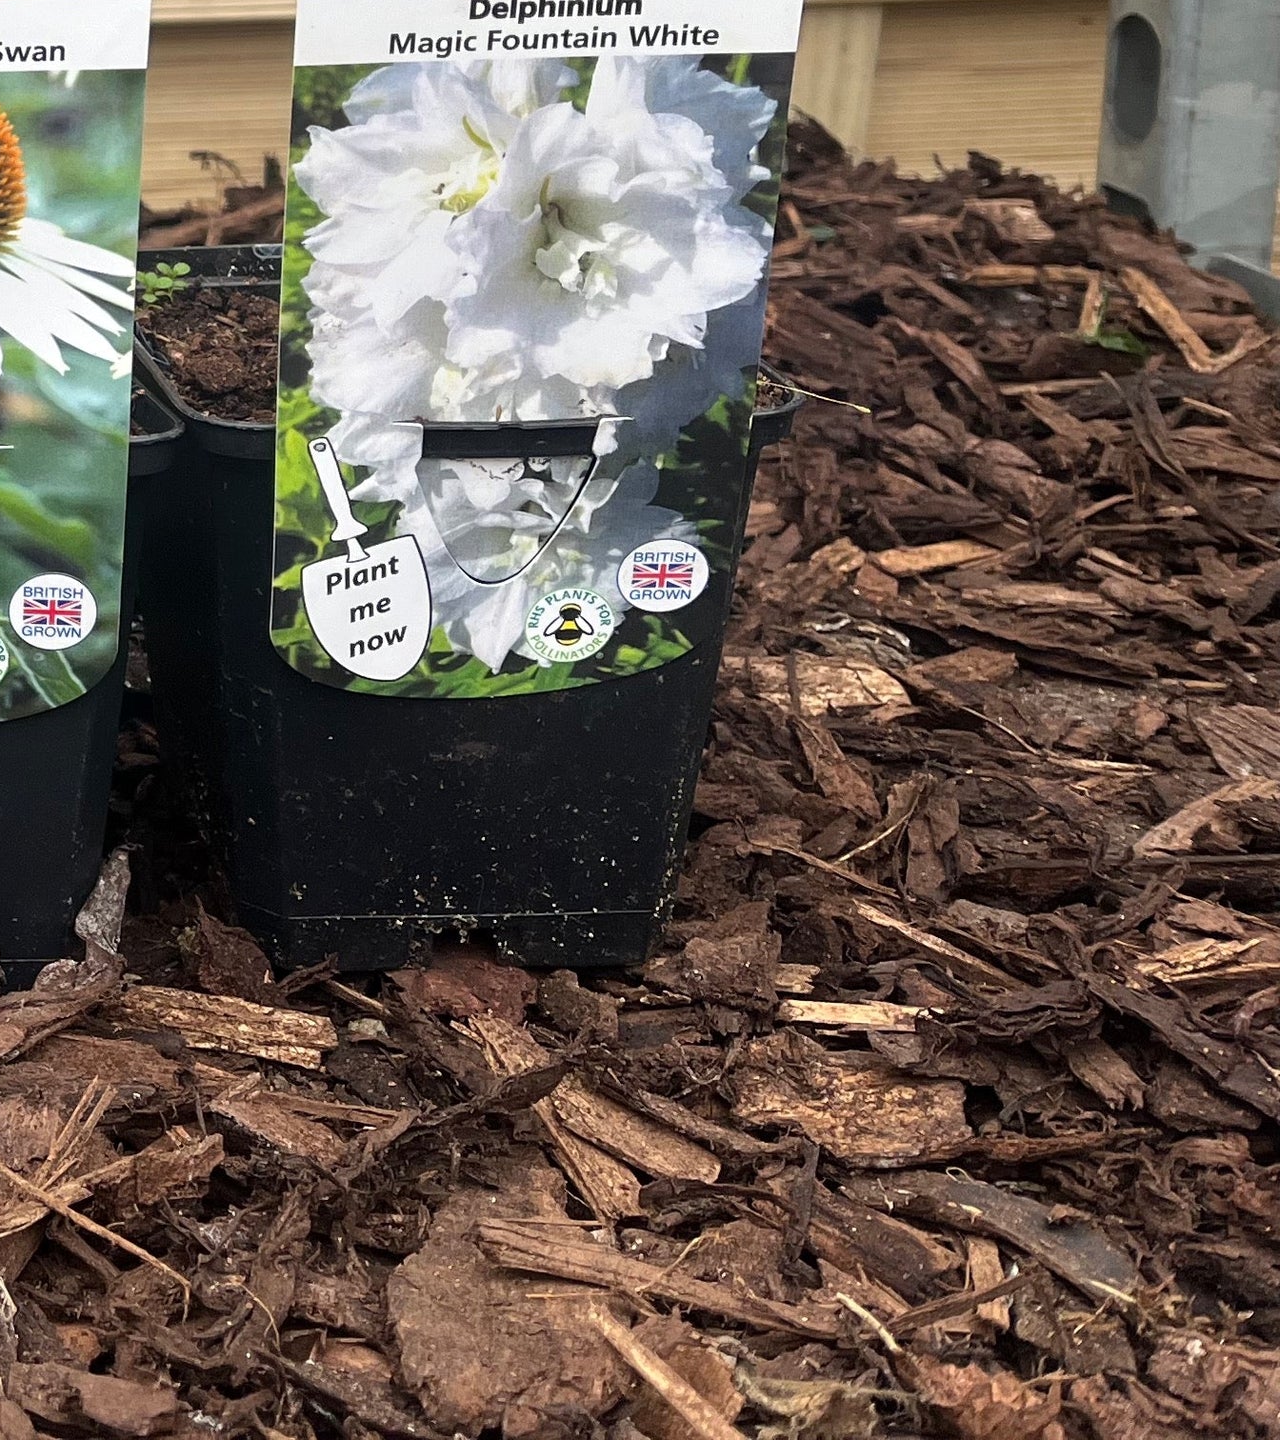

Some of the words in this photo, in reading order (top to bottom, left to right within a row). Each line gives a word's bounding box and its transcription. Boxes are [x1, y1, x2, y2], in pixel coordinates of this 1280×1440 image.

[389, 31, 477, 58] Magic
[487, 28, 618, 51] Fountain
[629, 26, 719, 46] White
[634, 552, 696, 562] BRITISH
[327, 556, 399, 595] Plant
[23, 587, 83, 599] BRITISH
[629, 590, 691, 600] GROWN
[350, 597, 391, 623] me
[529, 606, 545, 628] RHS
[545, 591, 598, 605] PLANTS
[596, 604, 611, 626] FOR
[22, 626, 81, 638] GROWN
[350, 626, 407, 657] now
[531, 632, 607, 659] POLLINATORS
